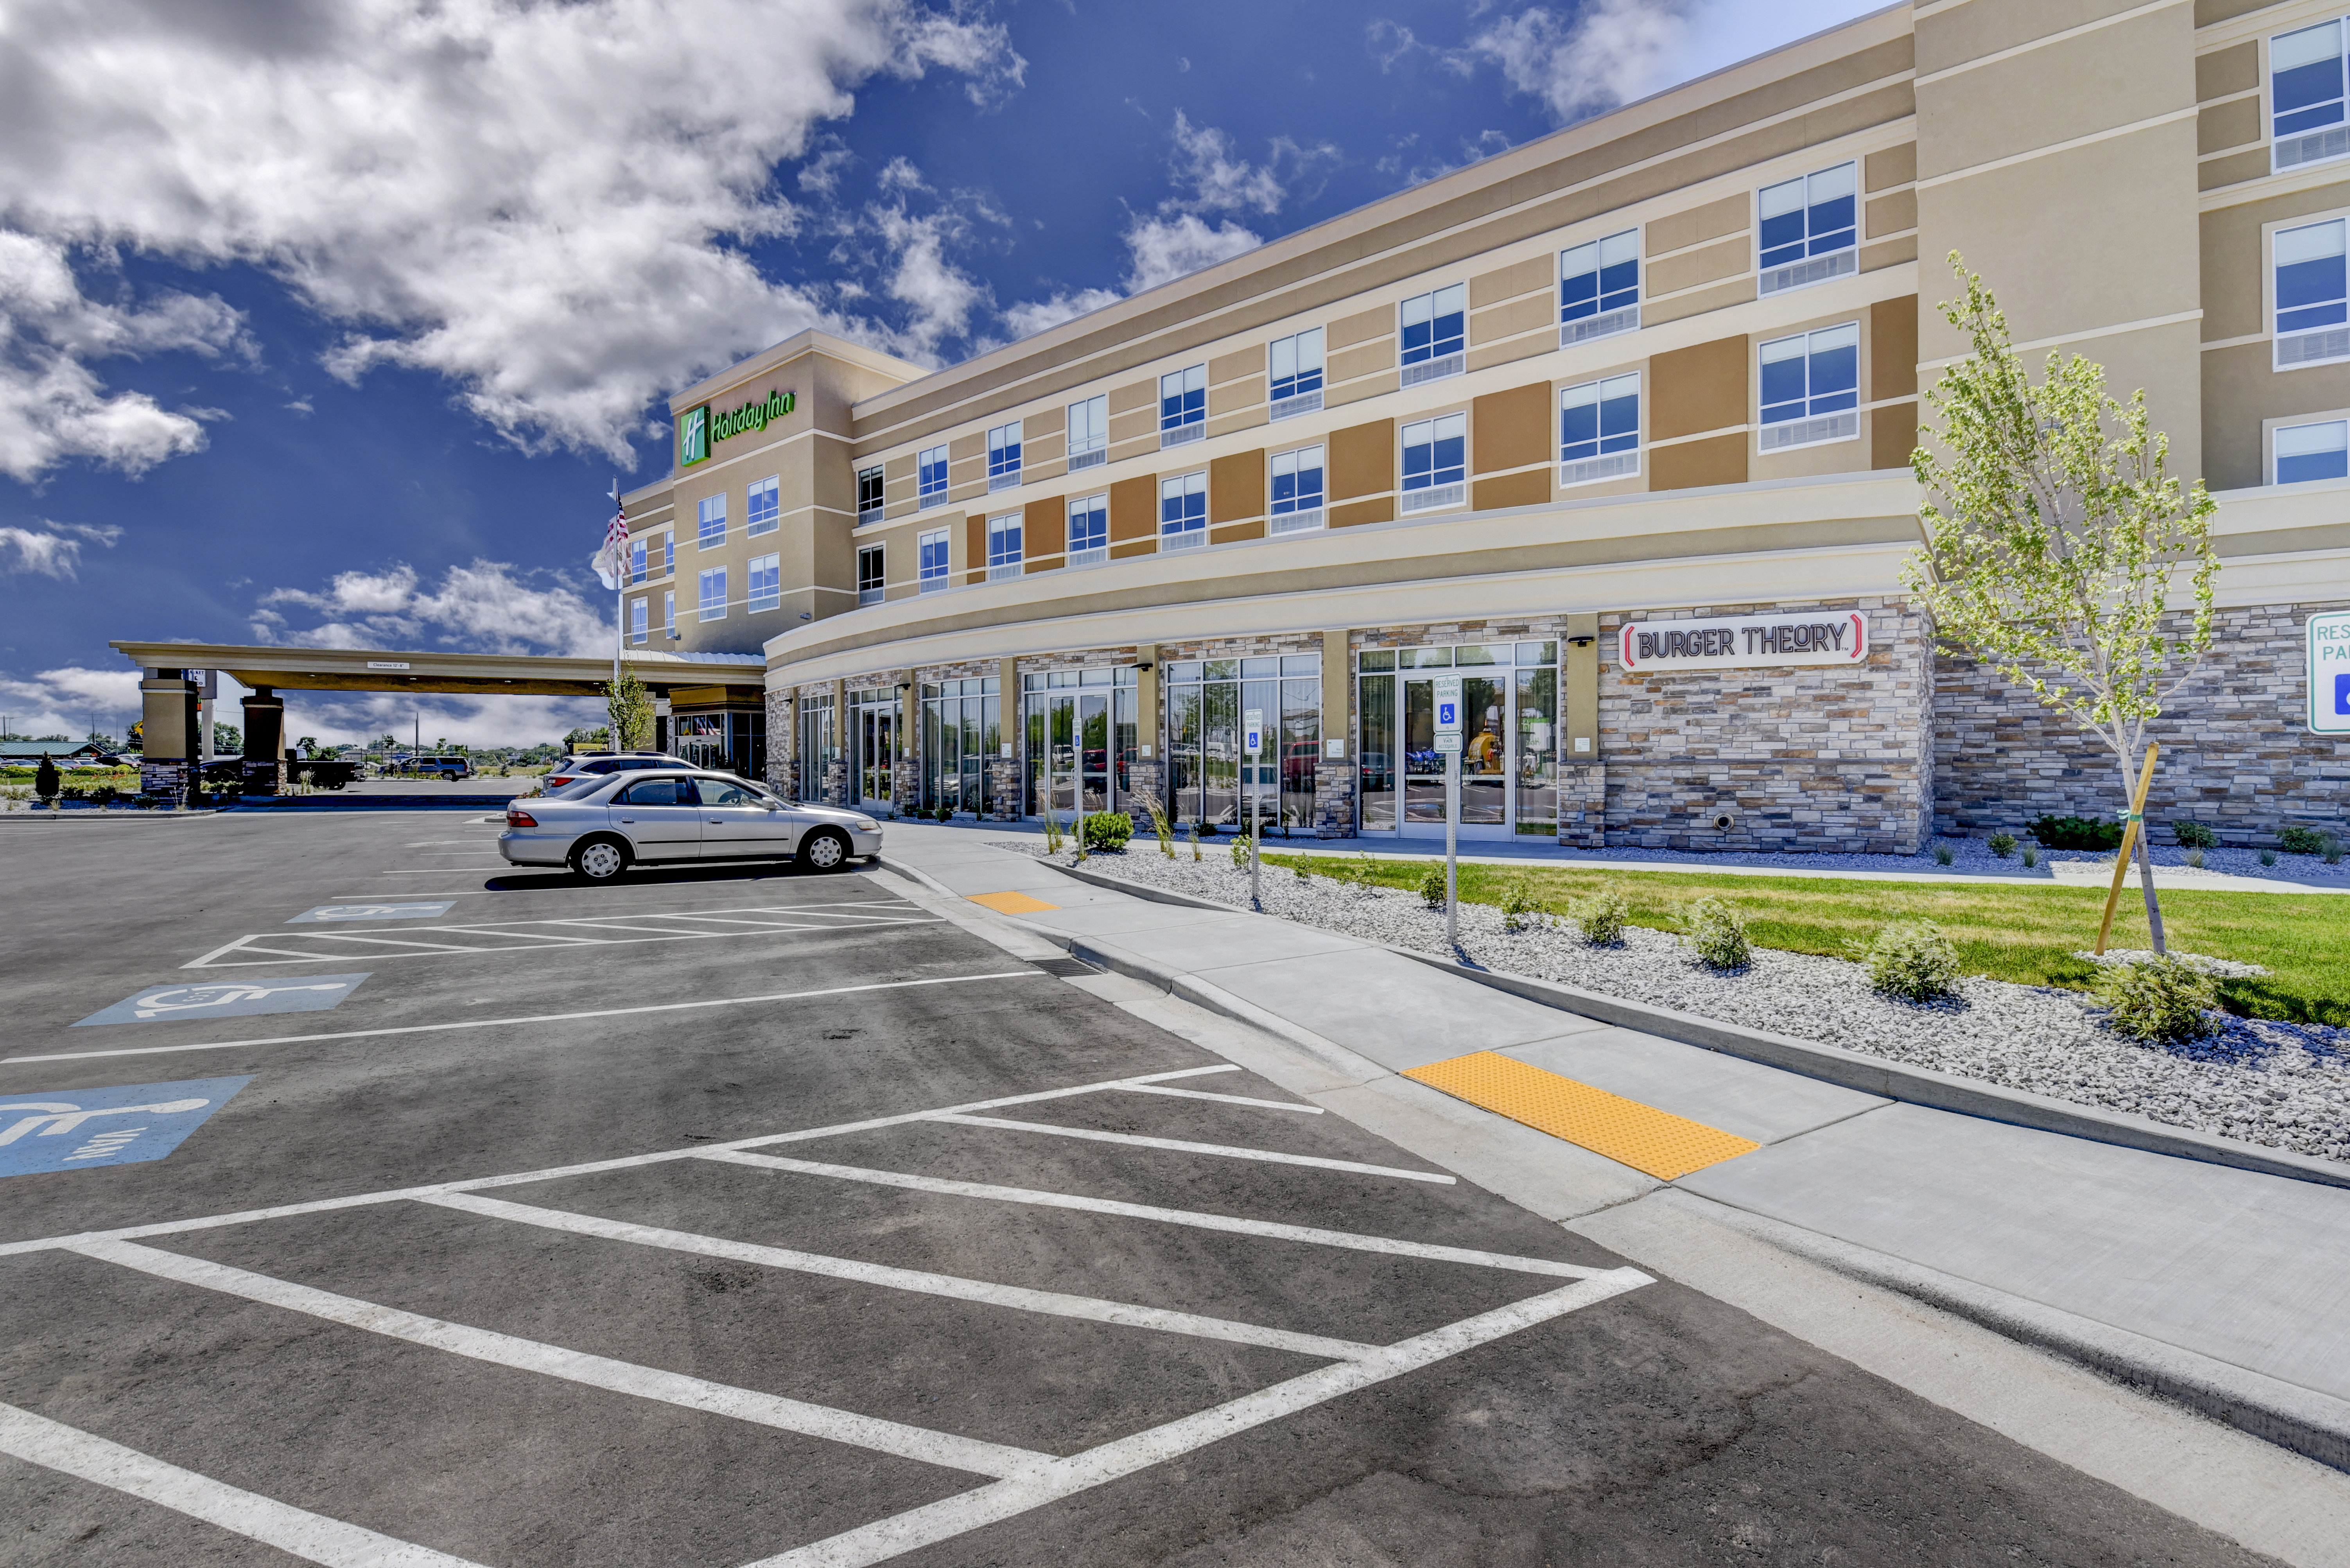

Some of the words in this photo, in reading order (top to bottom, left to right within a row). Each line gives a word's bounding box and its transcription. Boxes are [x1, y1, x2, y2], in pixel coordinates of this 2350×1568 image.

[710, 402, 766, 442] Holiday
[766, 390, 795, 420] Inn
[1638, 629, 1735, 658] BURGER
[1742, 623, 1848, 654] THEORY
[2323, 645, 2350, 660] PA
[1435, 679, 1459, 688] RESERVED
[1437, 689, 1458, 698] PARKING
